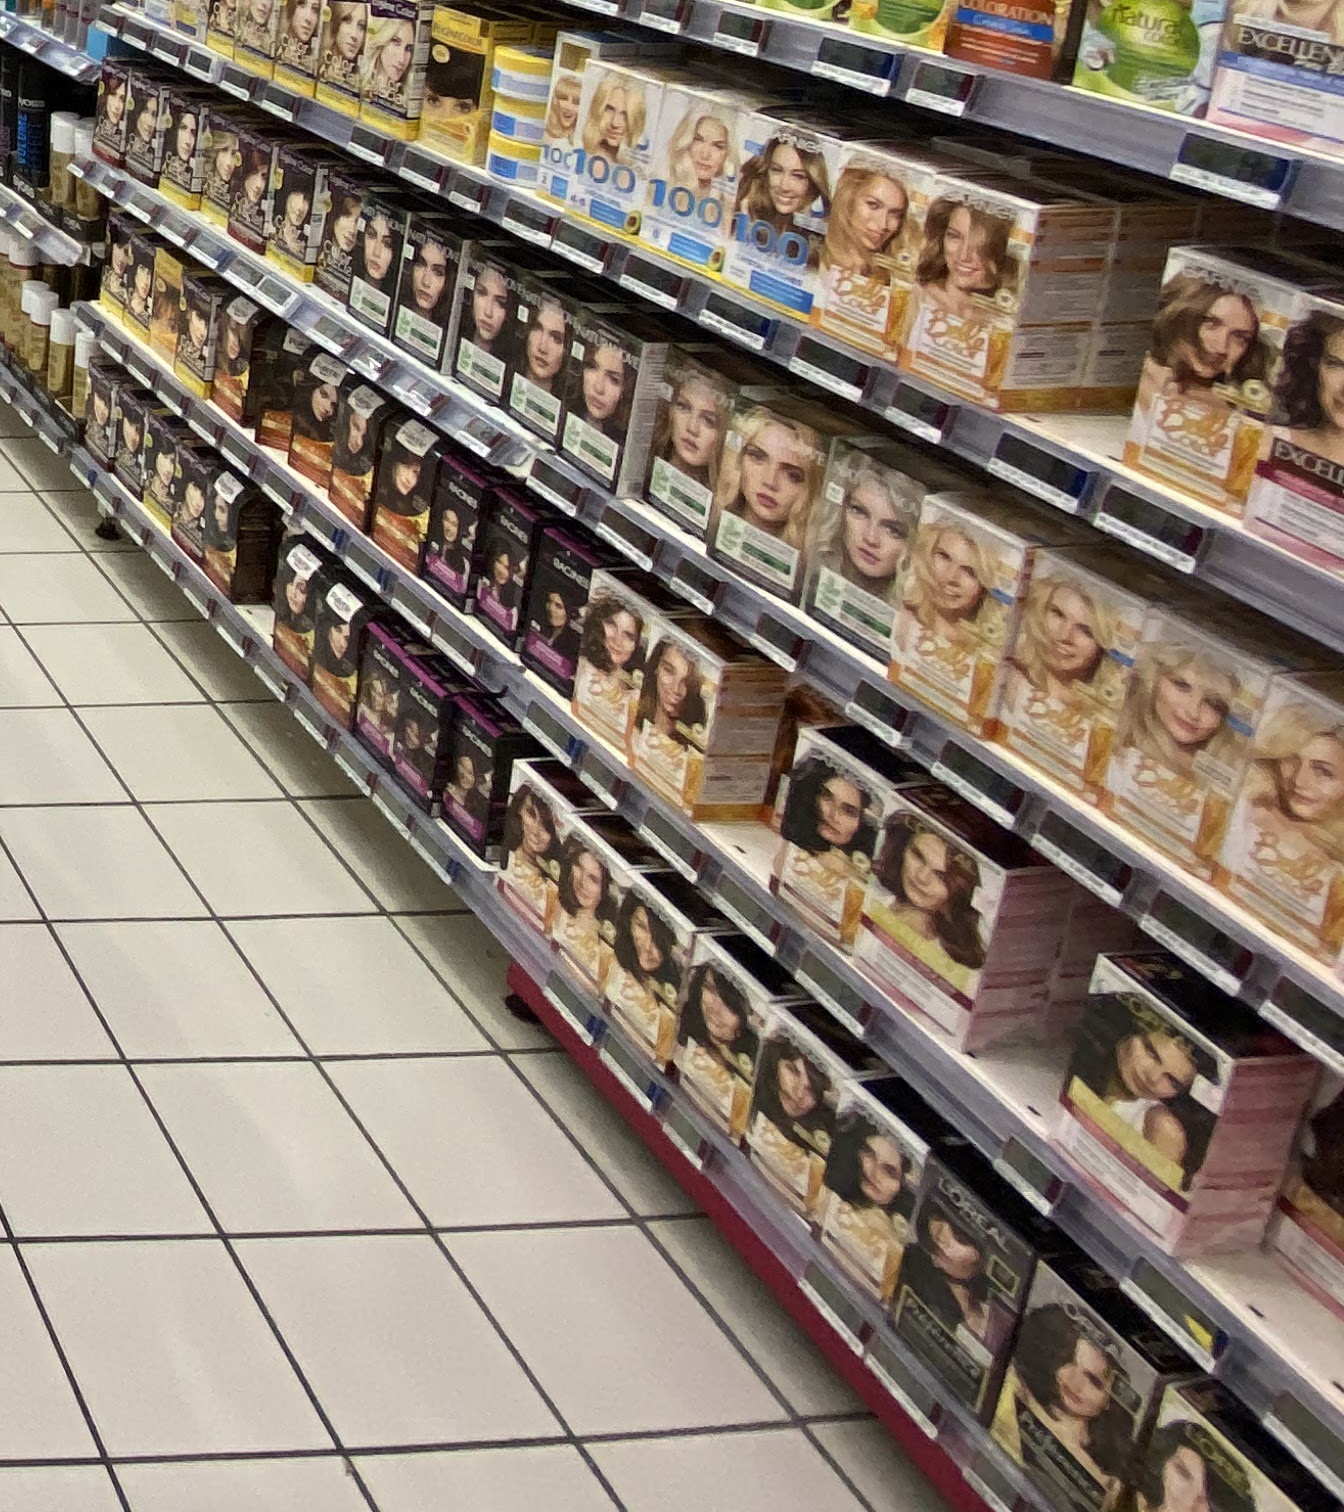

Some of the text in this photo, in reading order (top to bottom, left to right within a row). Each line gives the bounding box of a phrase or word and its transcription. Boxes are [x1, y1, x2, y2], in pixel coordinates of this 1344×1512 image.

[572, 148, 637, 194] 100
[648, 178, 723, 229] 100
[734, 213, 810, 266] 100
